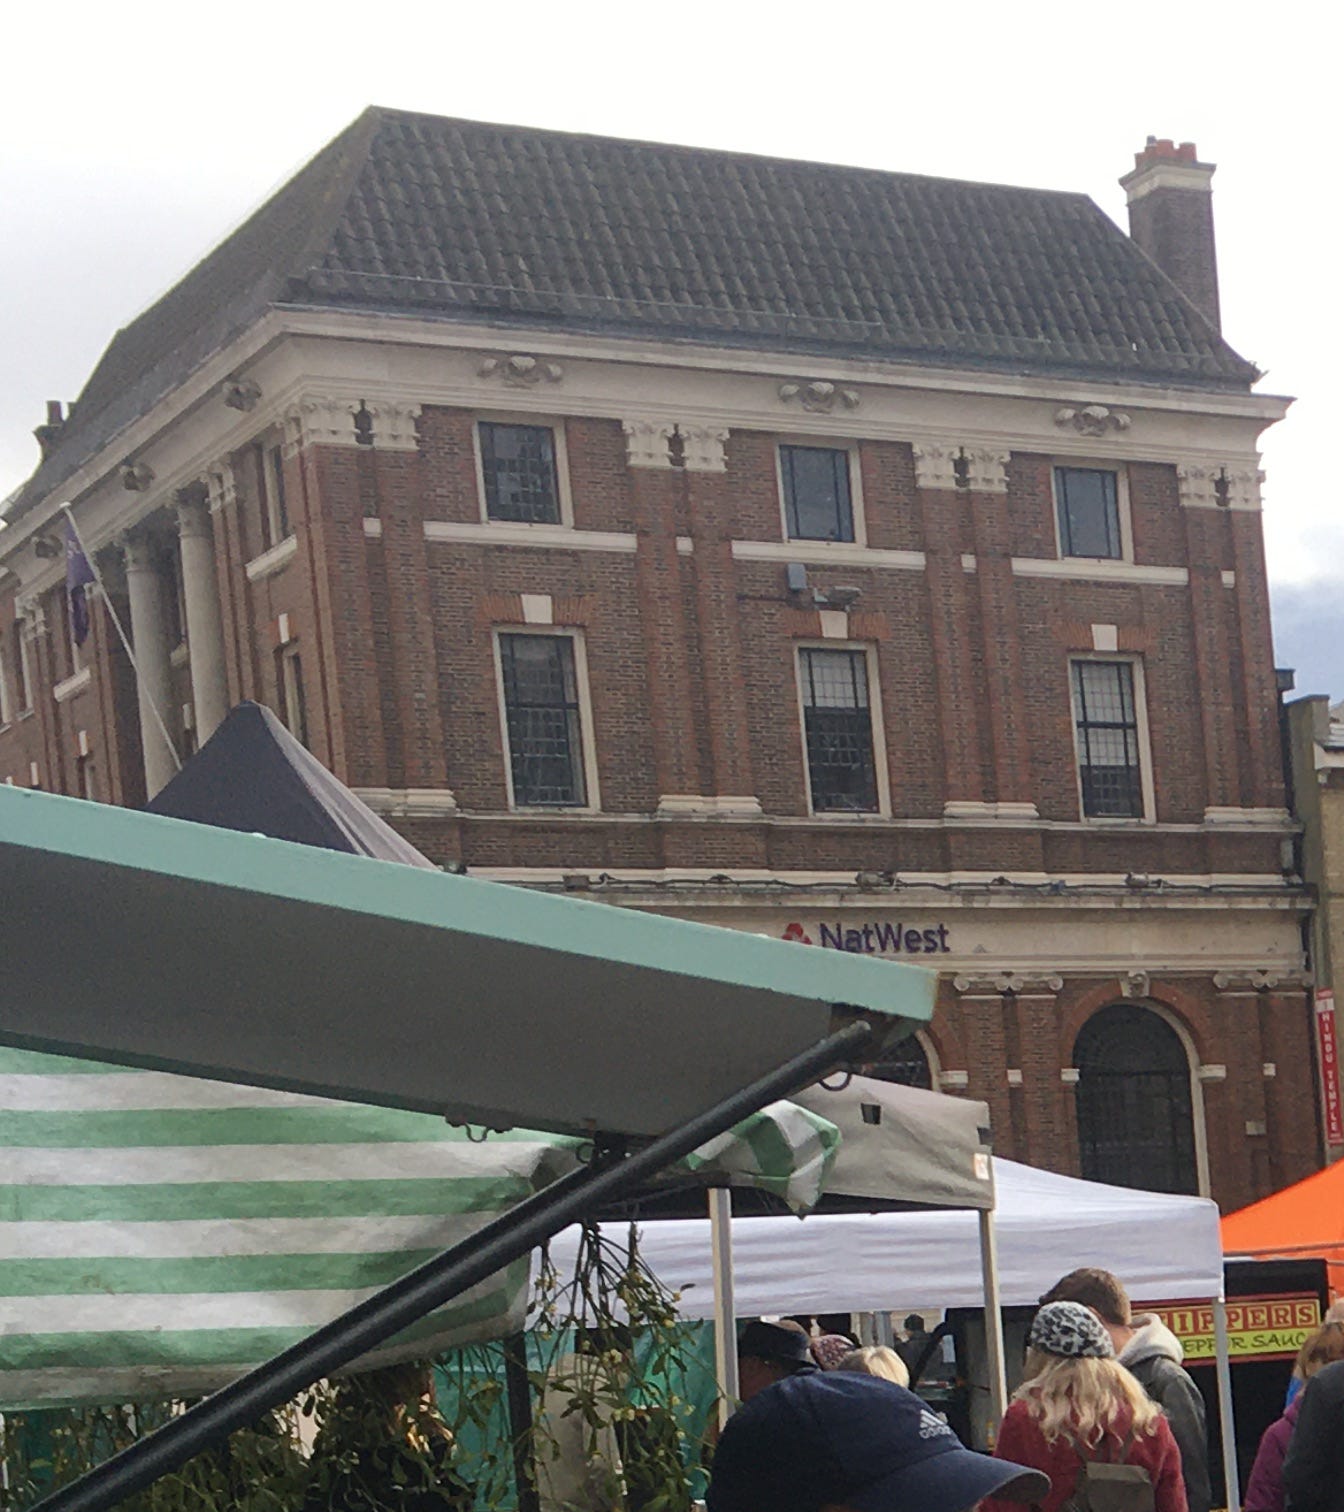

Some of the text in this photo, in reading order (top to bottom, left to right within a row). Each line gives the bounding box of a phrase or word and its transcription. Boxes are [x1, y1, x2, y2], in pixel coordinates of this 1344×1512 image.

[819, 922, 951, 953] NatWest
[1321, 1013, 1334, 1063] HINDU
[1327, 1070, 1338, 1131] TEMPLE
[1176, 1305, 1314, 1333] IPPERS
[1183, 1331, 1307, 1354] EPPR SAUC
